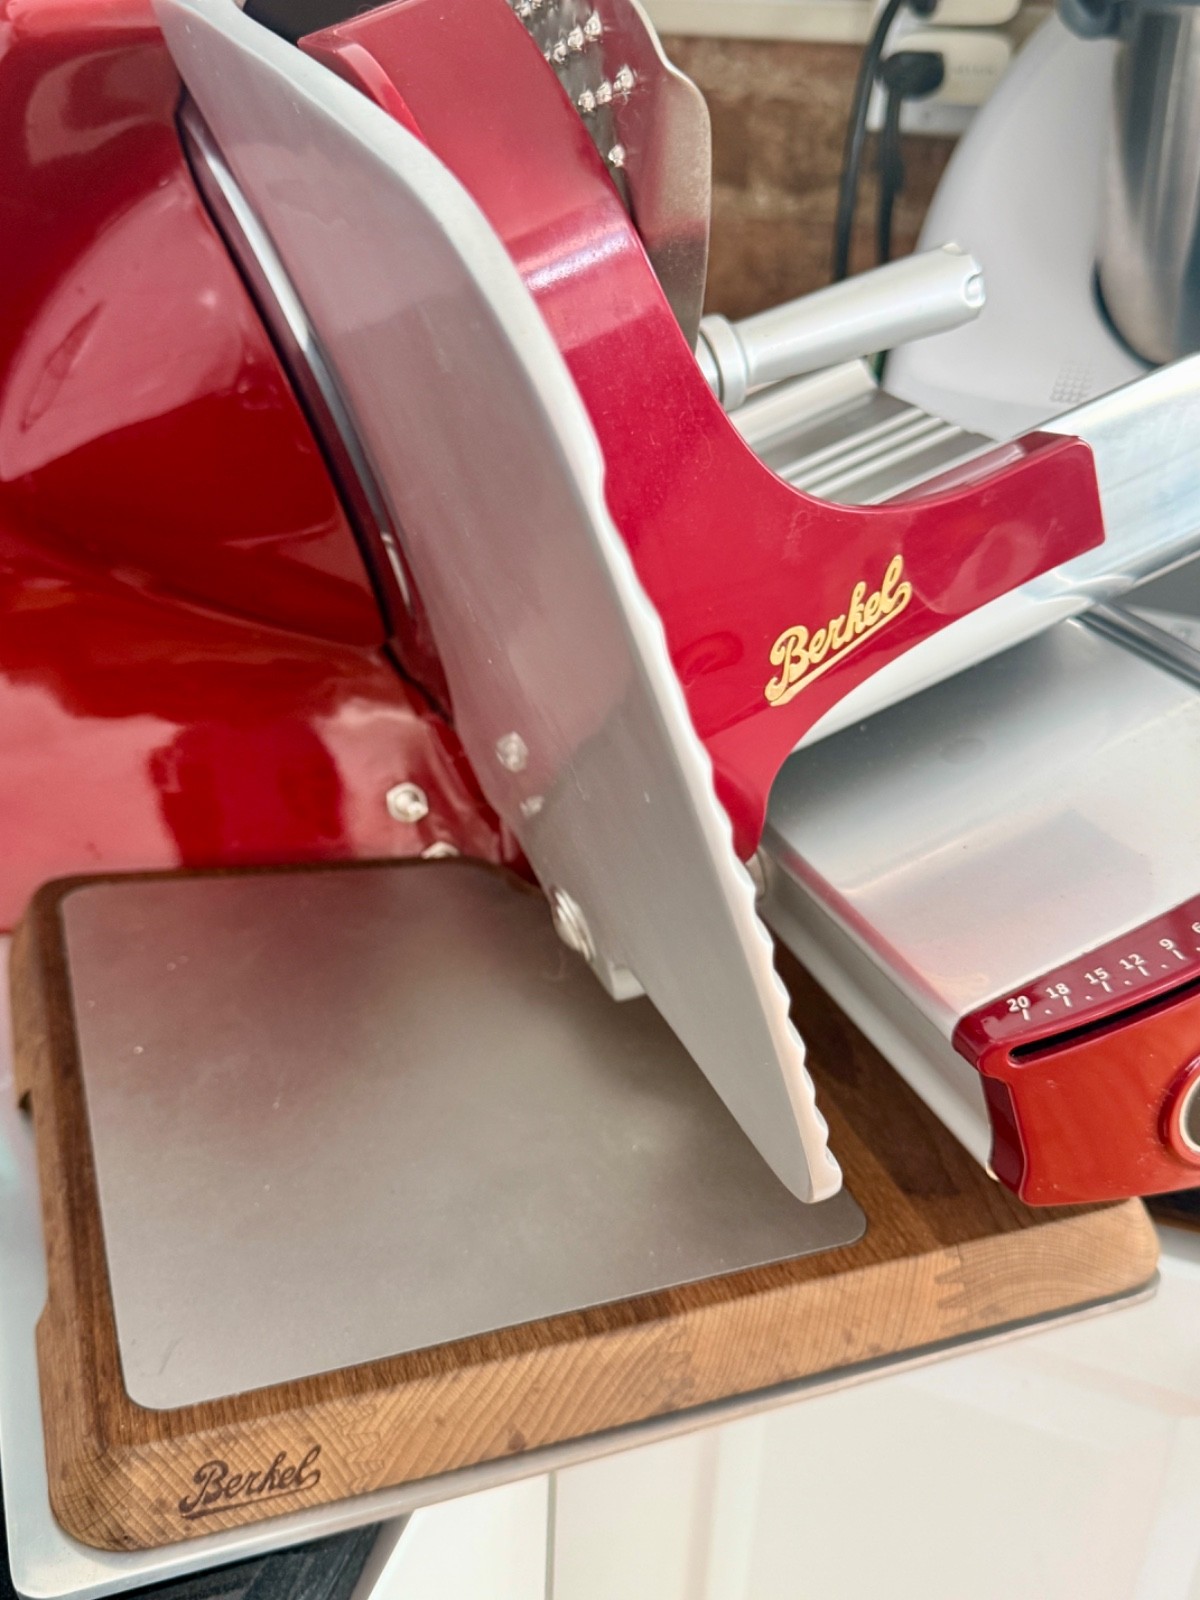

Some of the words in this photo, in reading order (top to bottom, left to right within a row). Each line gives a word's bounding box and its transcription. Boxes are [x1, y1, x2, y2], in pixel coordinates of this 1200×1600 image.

[764, 554, 912, 707] Berkel
[1006, 995, 1030, 1012] 20
[1046, 982, 1070, 999] 18
[1084, 967, 1109, 984] 15
[1119, 953, 1145, 970] 12
[1159, 938, 1173, 950] 9
[178, 1444, 321, 1520] Berkel
